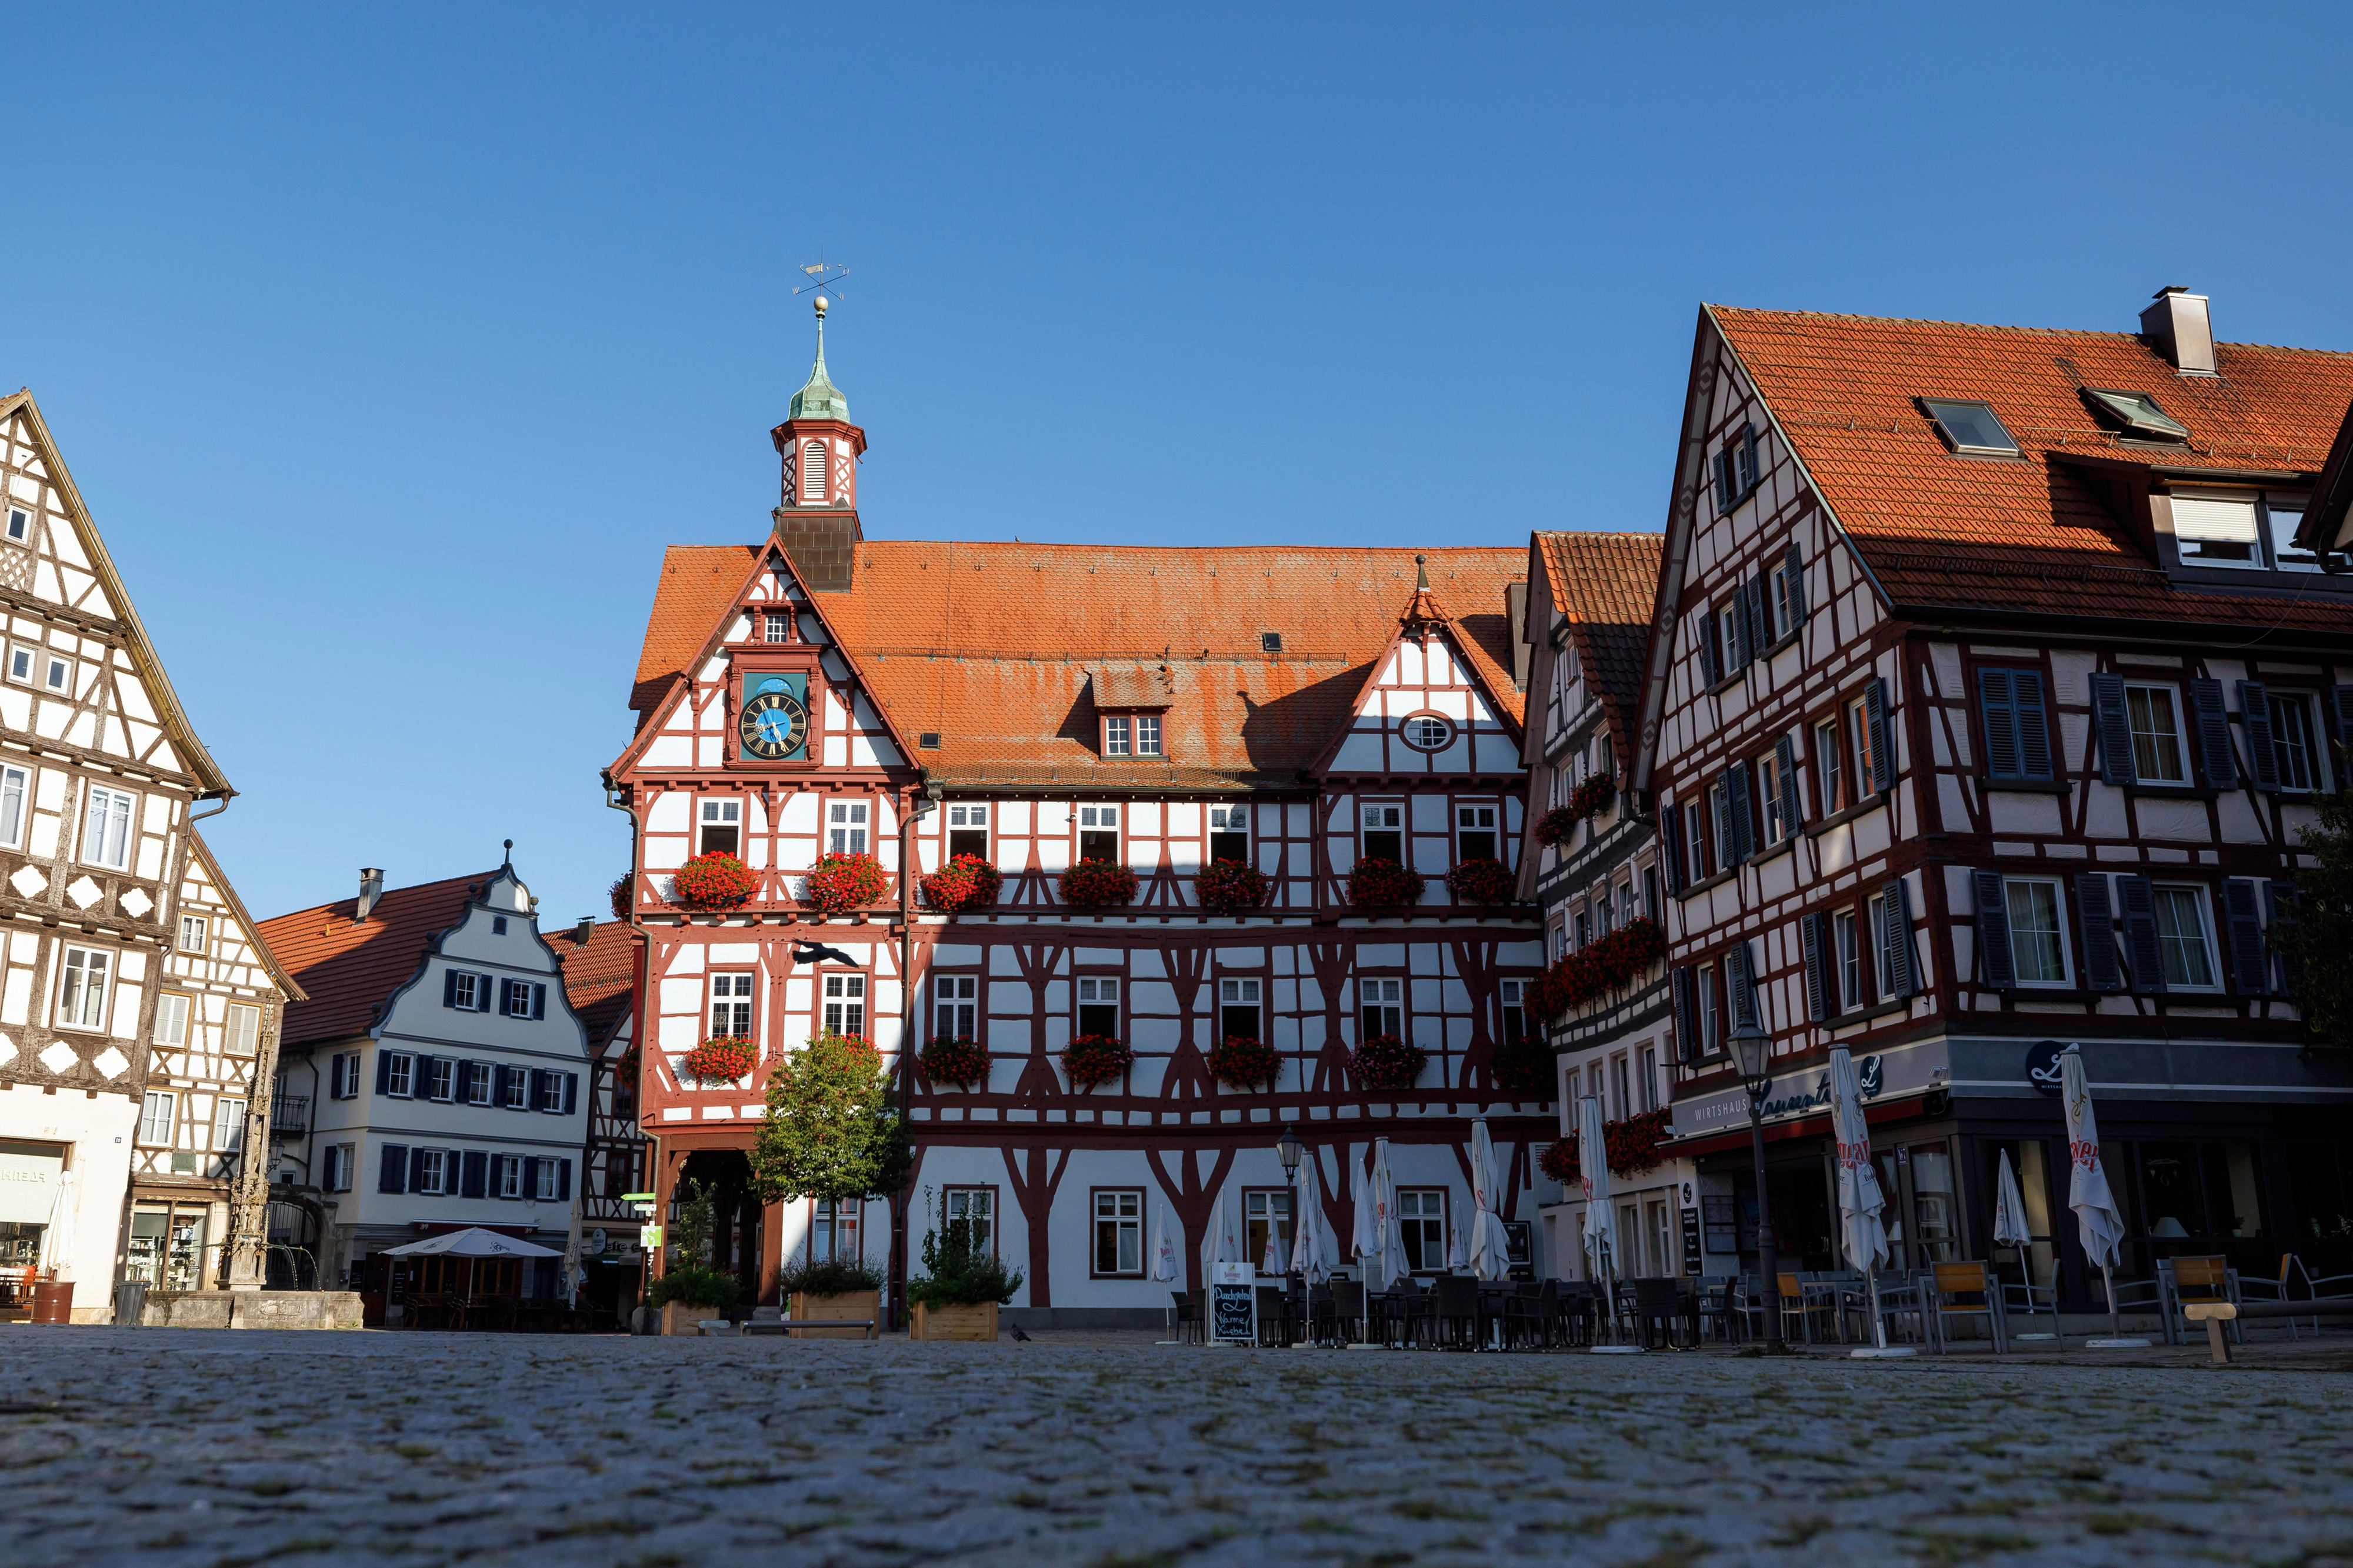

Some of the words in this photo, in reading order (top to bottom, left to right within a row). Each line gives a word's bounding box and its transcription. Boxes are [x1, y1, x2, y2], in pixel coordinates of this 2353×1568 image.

[1695, 1098, 1747, 1121] WIRTSHAUS
[1748, 1072, 1831, 1117] Laurenti
[606, 1240, 626, 1252] afe
[632, 1243, 641, 1252] e
[1215, 1311, 1245, 1325] Warme
